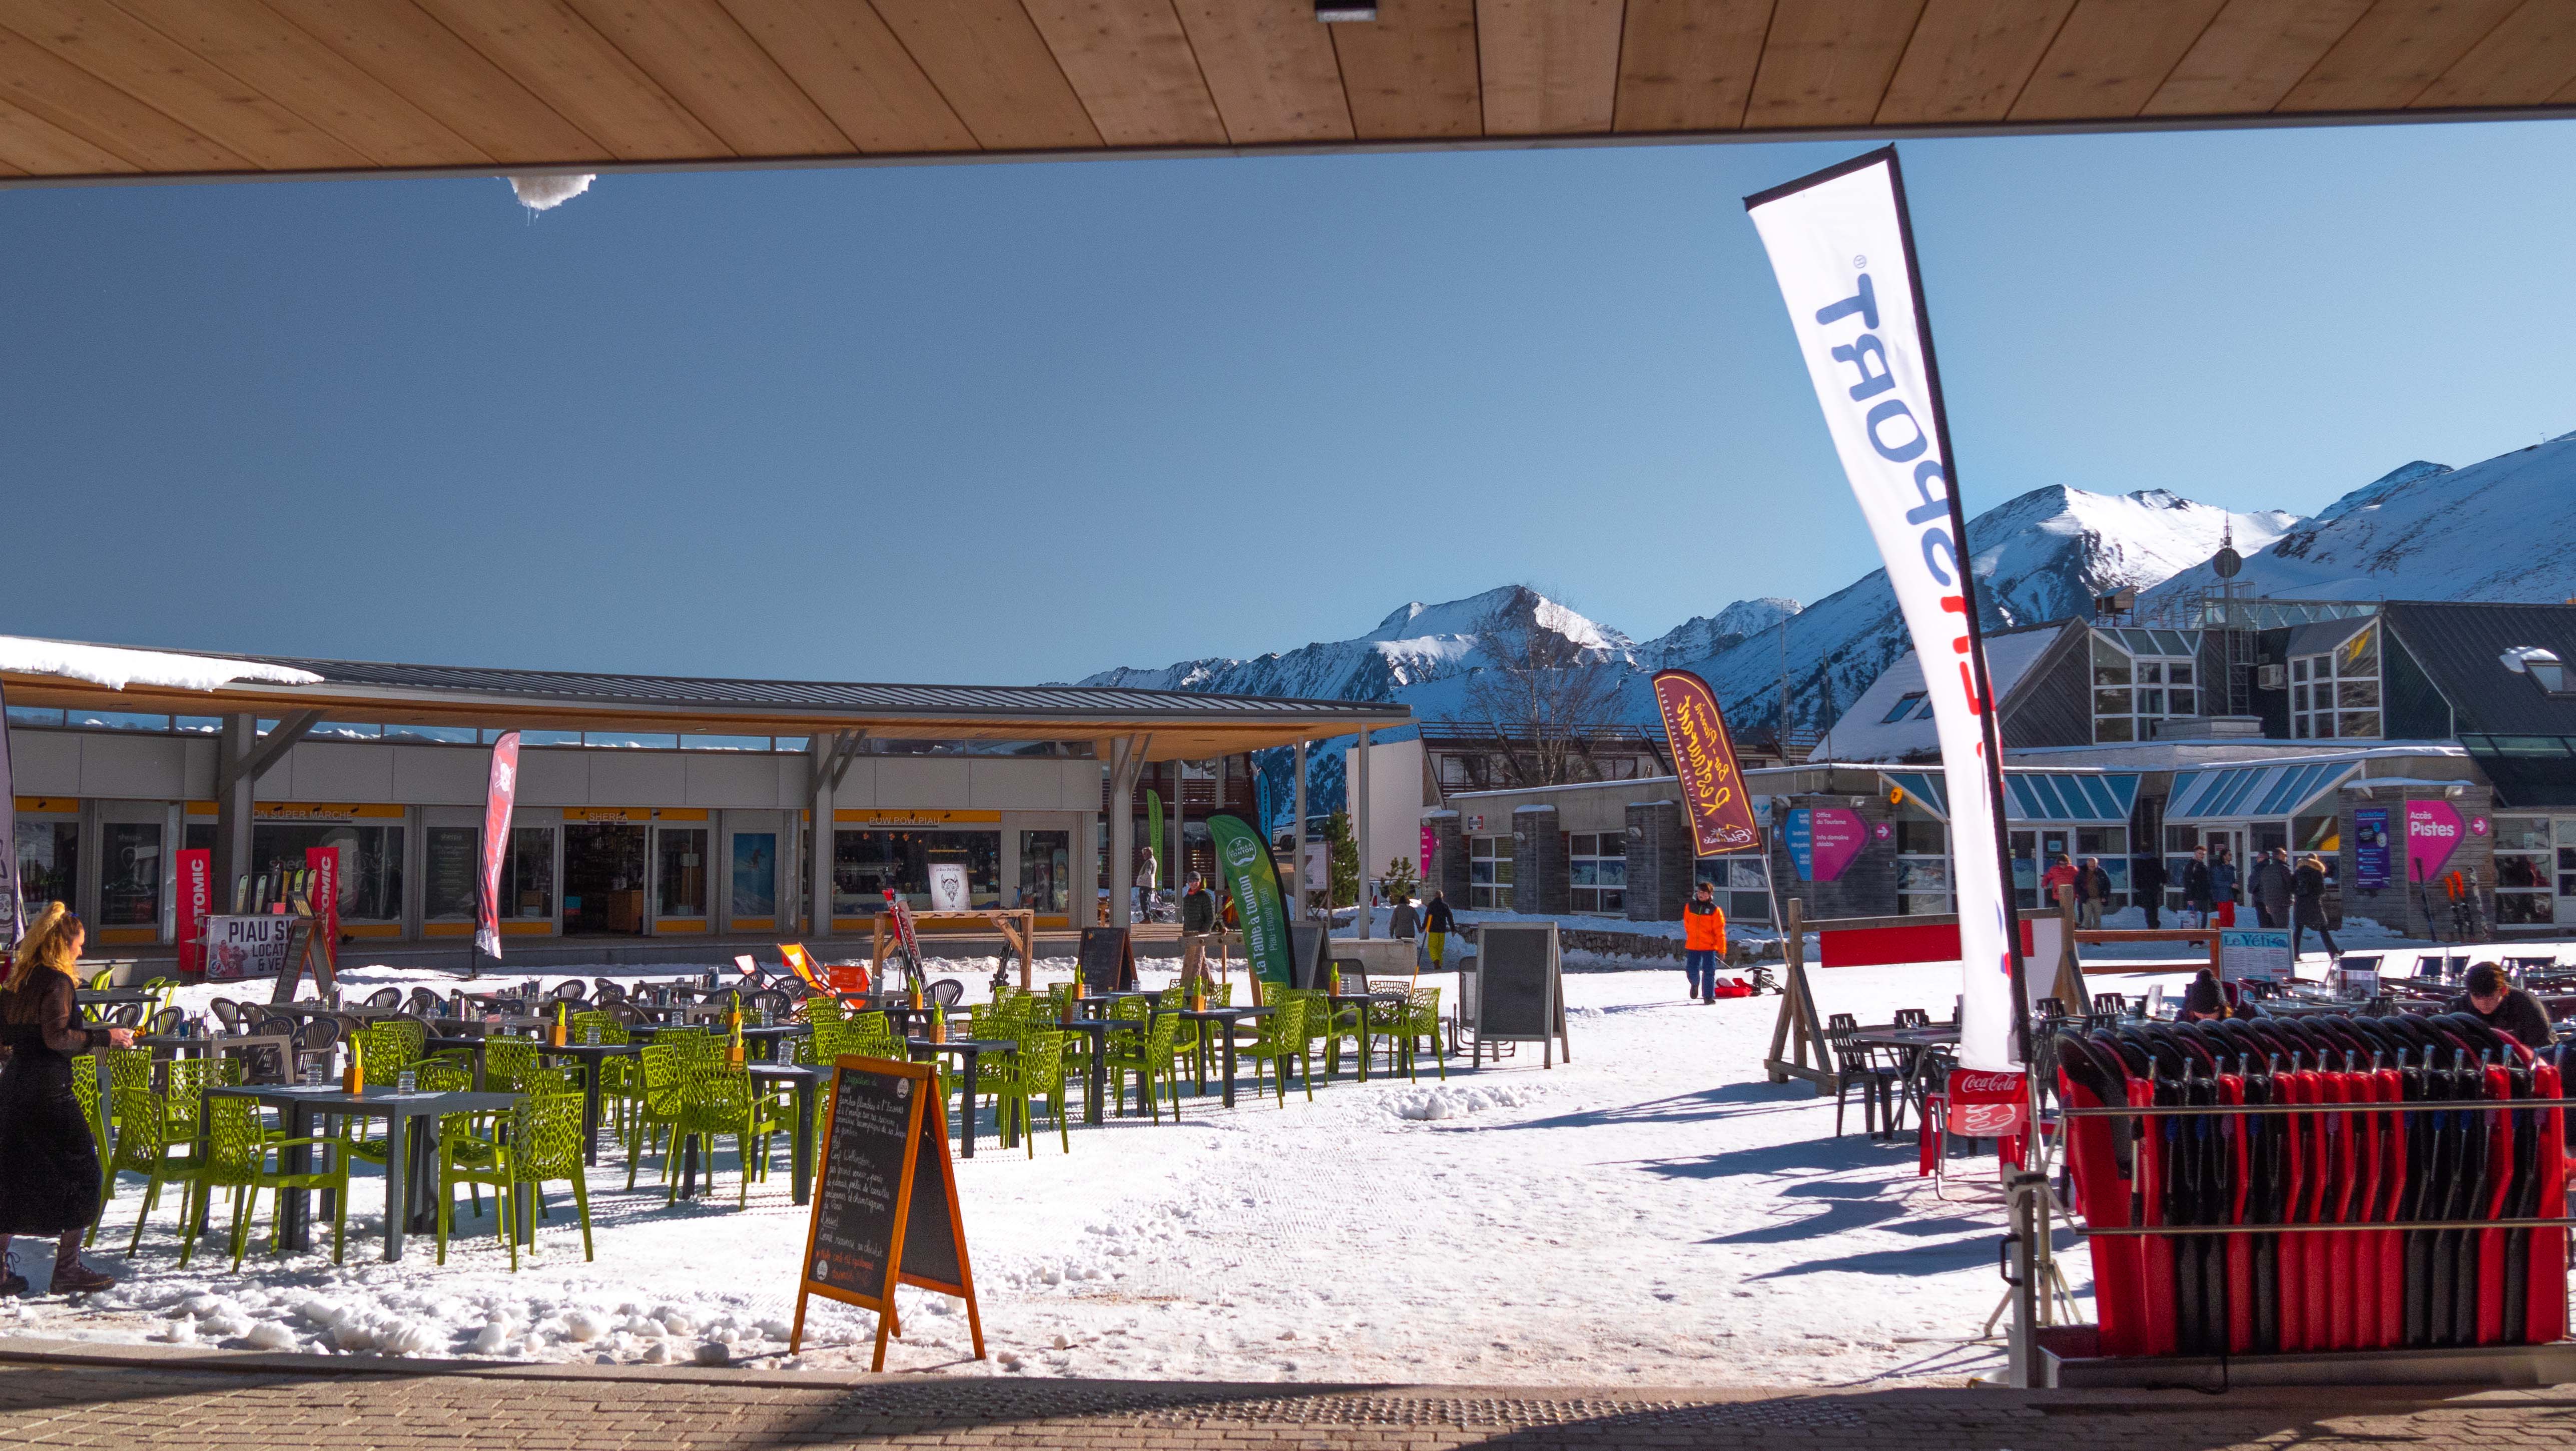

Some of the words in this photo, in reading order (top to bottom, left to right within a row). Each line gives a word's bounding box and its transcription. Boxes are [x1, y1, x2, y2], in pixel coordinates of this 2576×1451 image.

[253, 810, 267, 818] ON
[271, 810, 306, 819] SUPER
[869, 817, 891, 825] POW
[894, 817, 916, 825] POW
[918, 817, 940, 825] PIAU
[2410, 811, 2432, 819] Accès
[2411, 822, 2454, 836] Pistes
[1229, 847, 1253, 858] TONTON
[1238, 875, 1257, 916] tonton
[1248, 915, 1260, 926] à
[229, 921, 268, 943] PIAU
[1250, 926, 1265, 960] Table
[2224, 935, 2241, 947] Le
[1256, 959, 1267, 975] La
[1962, 1073, 2019, 1093] Coca-Cola
